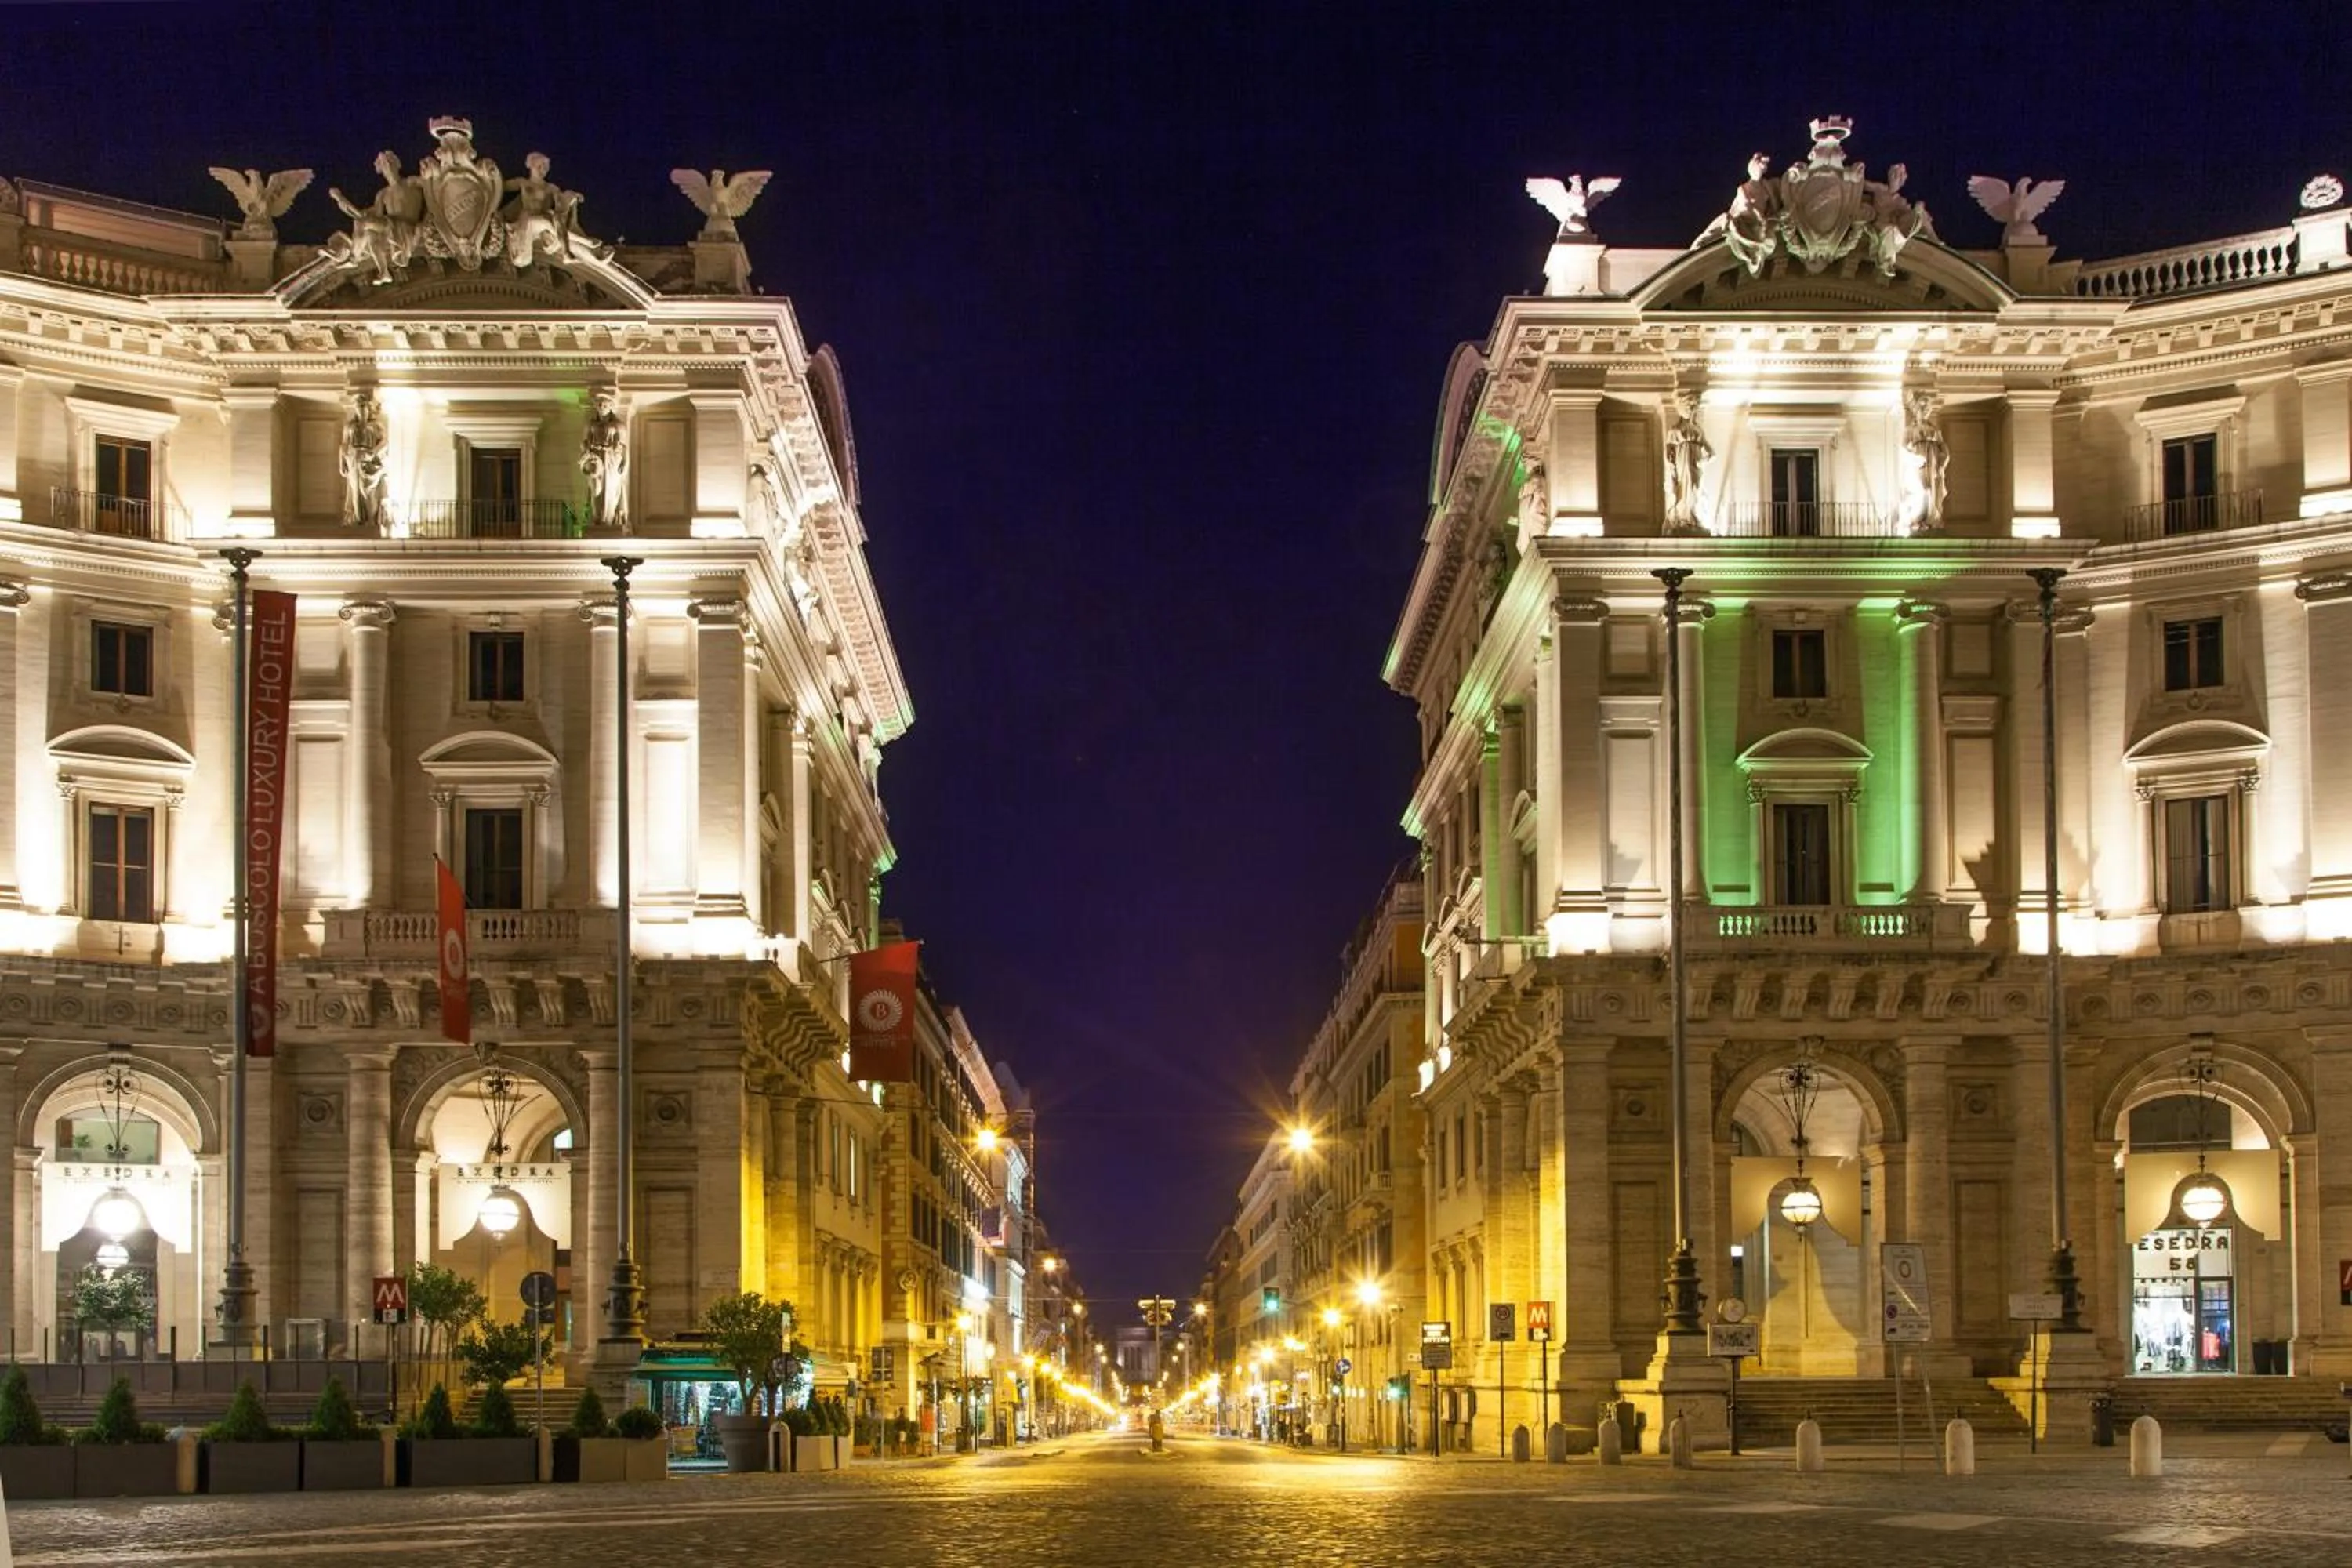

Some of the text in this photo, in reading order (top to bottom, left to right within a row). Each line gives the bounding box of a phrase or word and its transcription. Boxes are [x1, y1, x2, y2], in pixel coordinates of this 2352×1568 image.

[249, 610, 286, 994] A BOSCOLO LUXURY HOTEL
[64, 1167, 170, 1178] EXEDRA
[2138, 1236, 2229, 1250] ESEDRA
[377, 1283, 405, 1303] M
[1530, 1307, 1547, 1324] M
